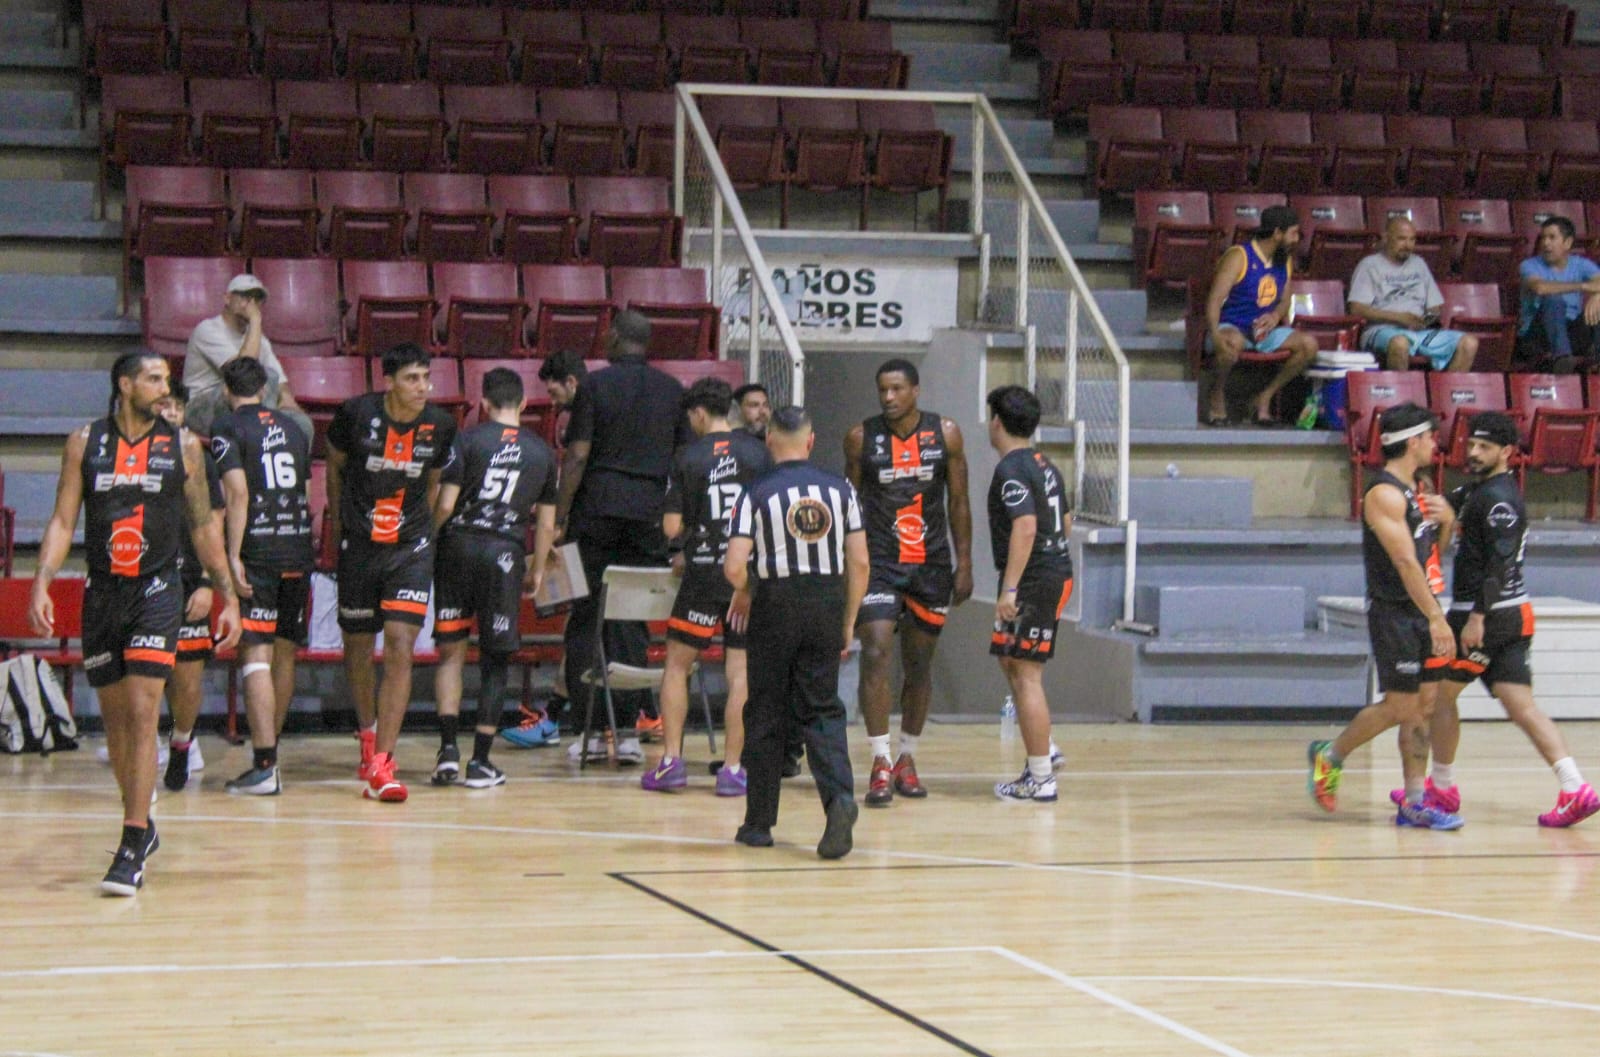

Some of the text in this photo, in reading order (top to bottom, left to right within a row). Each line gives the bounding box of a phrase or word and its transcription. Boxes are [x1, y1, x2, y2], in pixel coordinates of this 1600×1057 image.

[261, 452, 296, 489] 16
[478, 467, 520, 504] 51
[708, 484, 742, 520] 13
